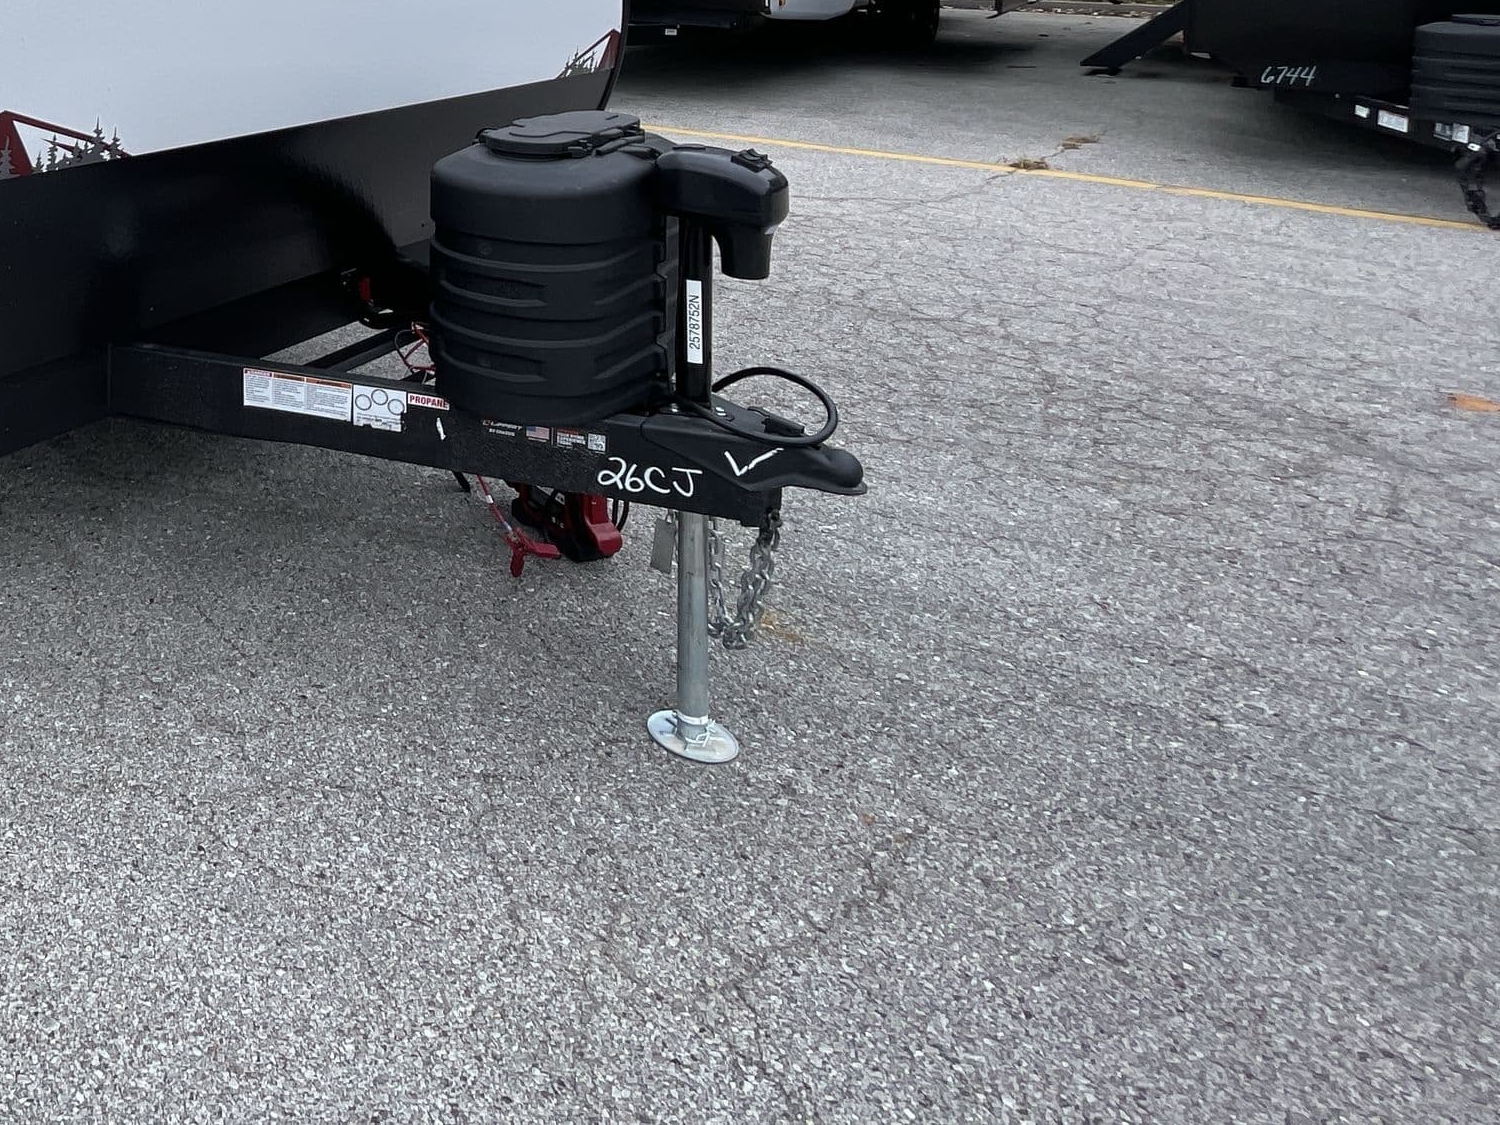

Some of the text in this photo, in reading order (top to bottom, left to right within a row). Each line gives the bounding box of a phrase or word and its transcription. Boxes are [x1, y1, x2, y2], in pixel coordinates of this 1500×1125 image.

[1260, 65, 1317, 87] 6744
[688, 294, 701, 351] 2578752N
[597, 457, 704, 498] 26CJ
